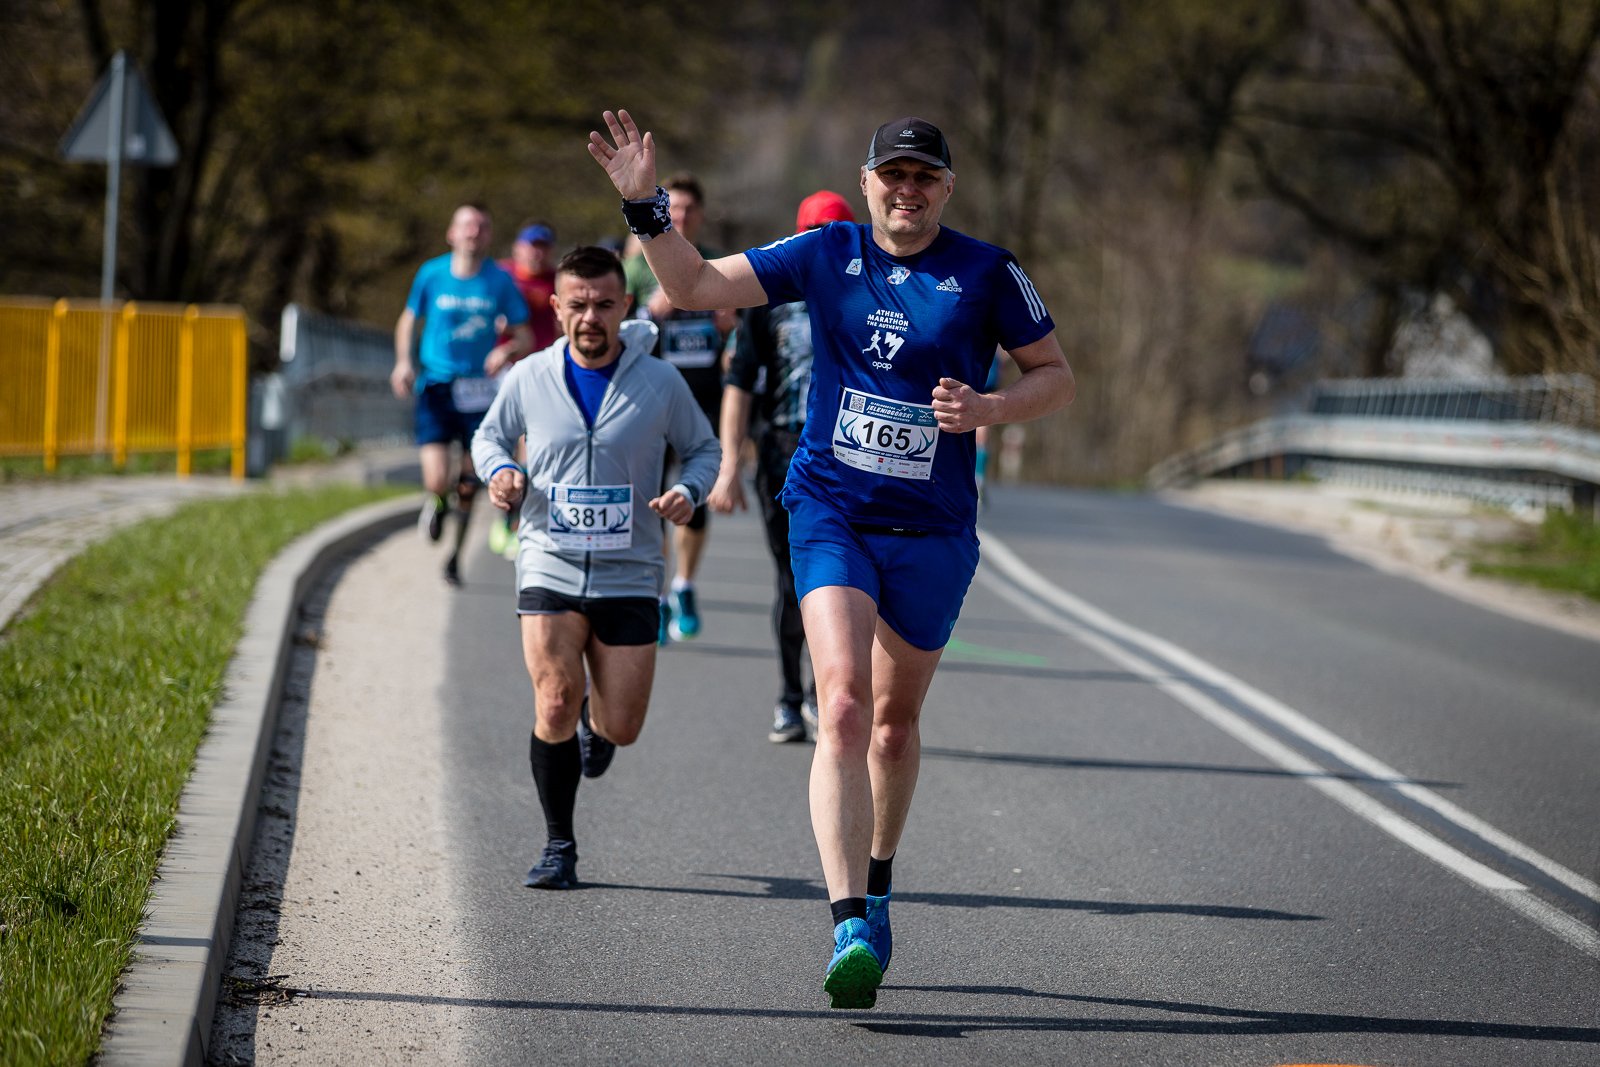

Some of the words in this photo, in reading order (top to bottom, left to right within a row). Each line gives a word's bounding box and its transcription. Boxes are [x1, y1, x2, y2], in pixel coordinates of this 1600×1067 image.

[936, 285, 962, 293] adidas
[875, 309, 904, 319] ATHENS
[867, 314, 909, 327] MARATHON
[878, 322, 908, 332] AUTHENTIC
[872, 361, 892, 371] opap
[862, 421, 912, 451] 165
[569, 507, 608, 527] 381
